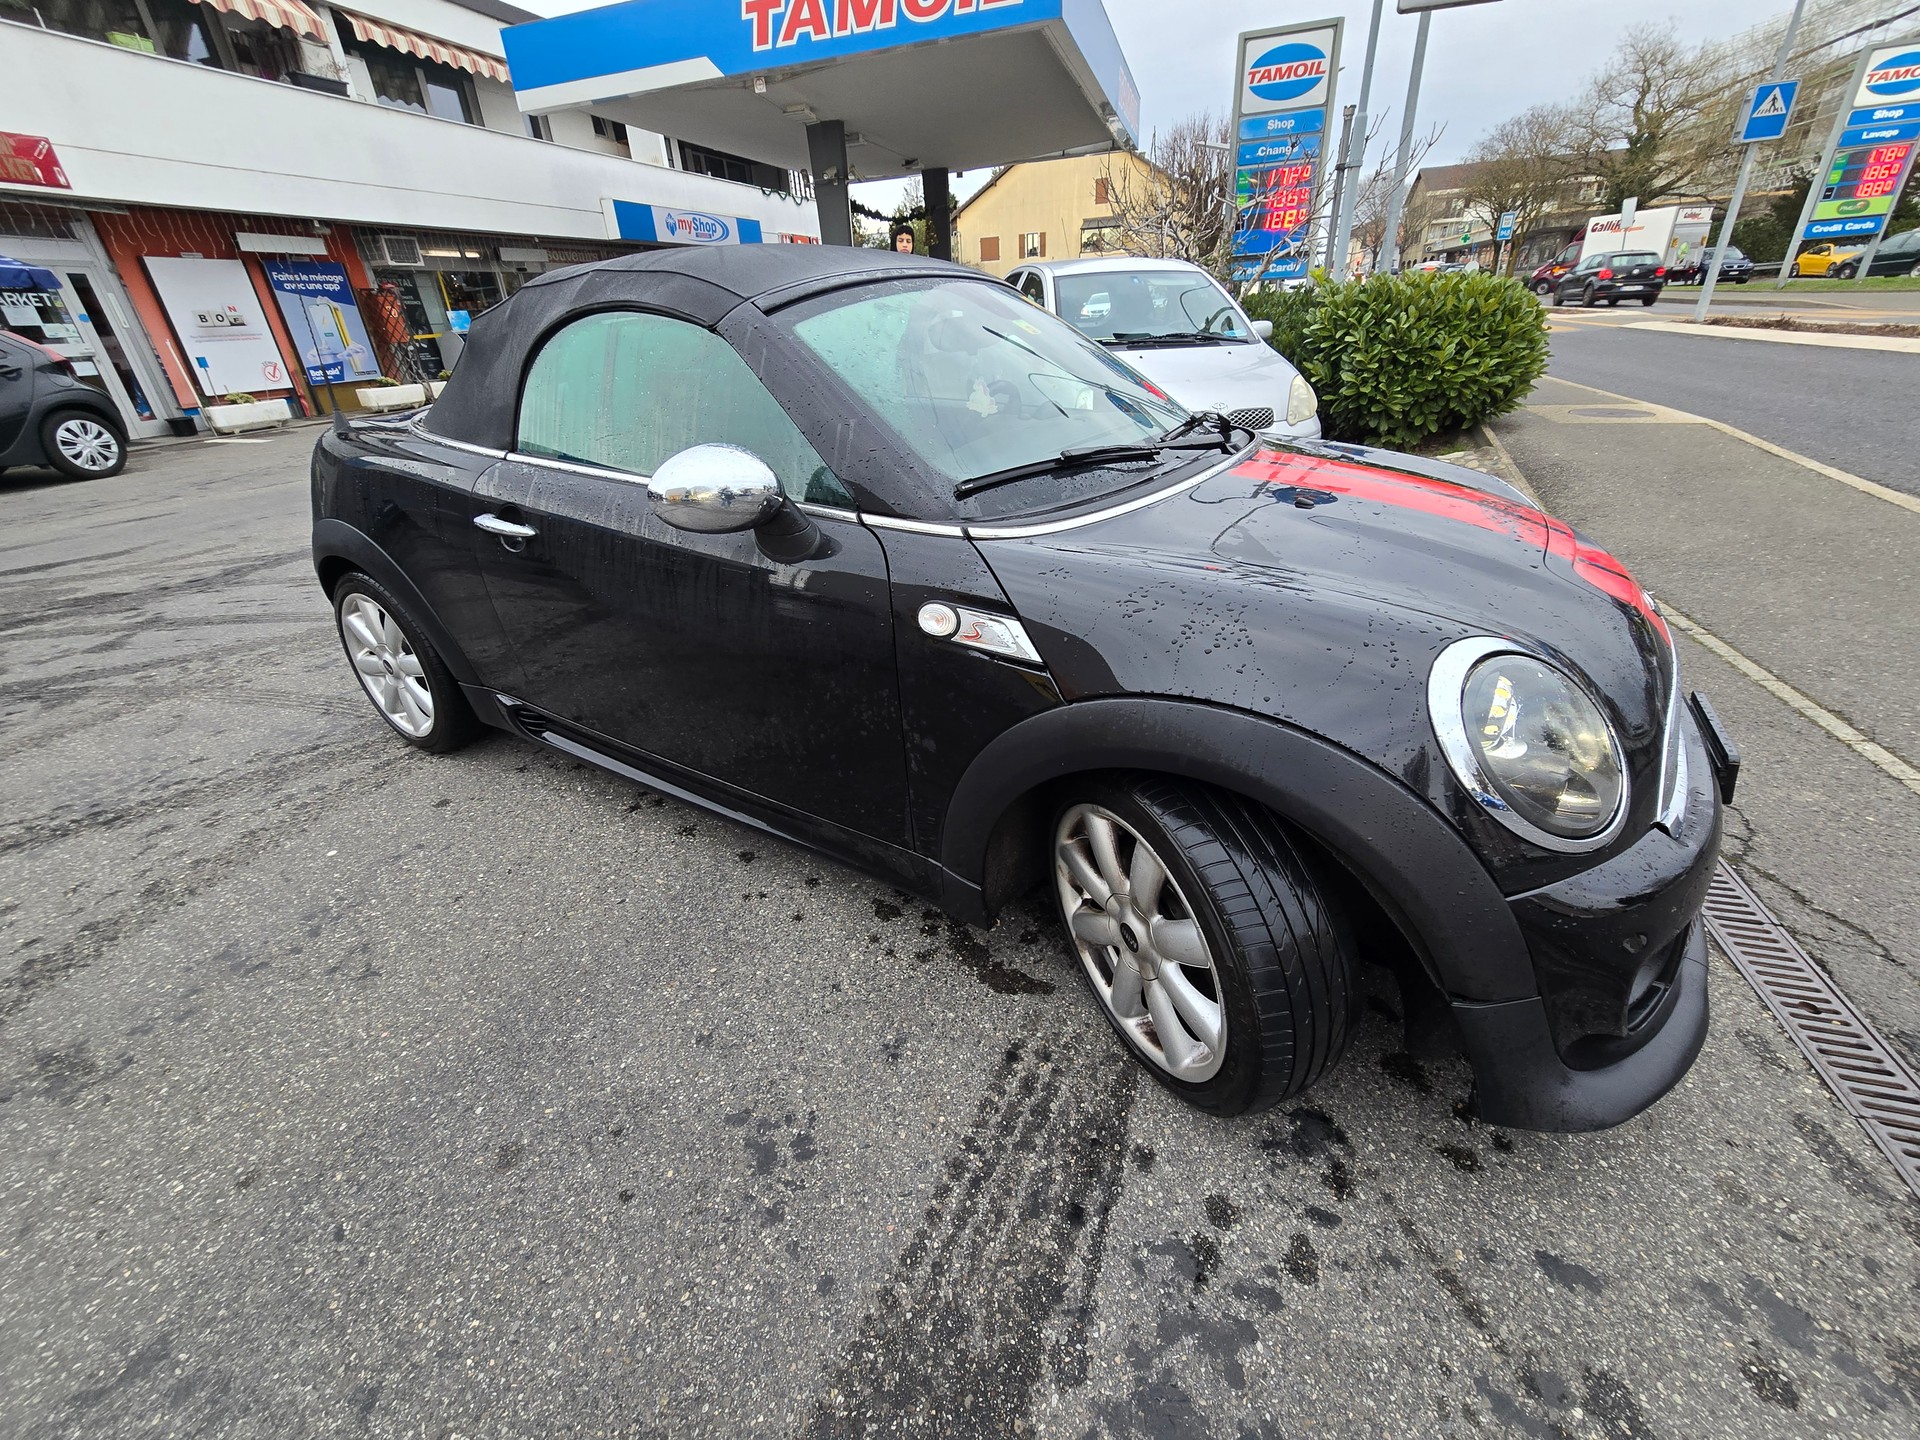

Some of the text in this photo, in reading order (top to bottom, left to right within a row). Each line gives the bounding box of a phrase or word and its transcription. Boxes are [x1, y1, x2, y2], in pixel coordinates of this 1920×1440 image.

[741, 0, 1024, 52] TAM
[1248, 61, 1326, 84] TAMOIL
[1873, 109, 1904, 119] Shop
[1268, 120, 1295, 130] Shop
[677, 216, 717, 237] myShop
[1591, 219, 1635, 233] Gallik
[1812, 221, 1875, 233] Credit Cards
[299, 272, 309, 281] le
[309, 272, 344, 283] ménage
[323, 283, 340, 291] app
[309, 366, 341, 377] Bataid
